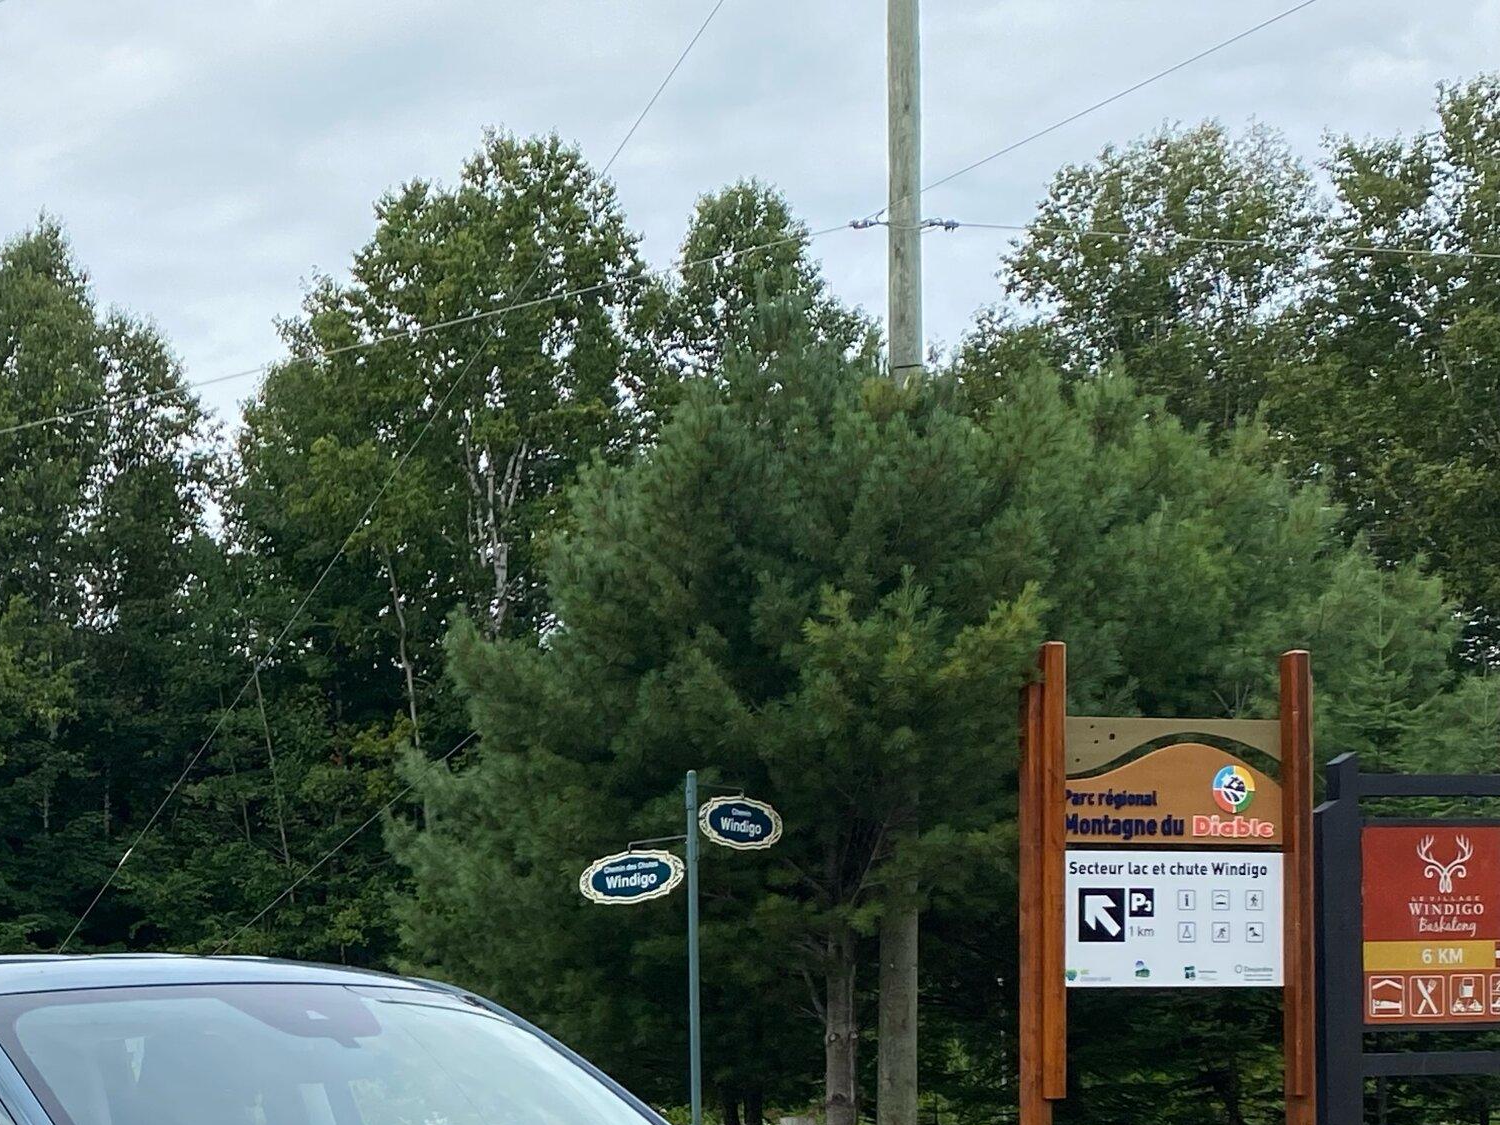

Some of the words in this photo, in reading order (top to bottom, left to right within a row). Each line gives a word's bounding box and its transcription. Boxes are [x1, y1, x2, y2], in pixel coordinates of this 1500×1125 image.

[1065, 789, 1095, 806] Parc
[1098, 788, 1158, 810] régional
[720, 816, 762, 837] Windigo
[1065, 813, 1158, 840] Montagne
[1161, 814, 1185, 836] du
[1192, 815, 1275, 838] Diable
[1069, 861, 1122, 875] Secteur
[1128, 861, 1149, 875] lac
[1152, 862, 1166, 875] et
[1170, 861, 1208, 875] chute
[1211, 861, 1268, 879] Windigo
[605, 872, 658, 889] Windigo
[1408, 902, 1485, 916] WINDIGO
[1137, 925, 1155, 937] km
[1422, 948, 1433, 964] 6
[1438, 948, 1464, 964] KM
